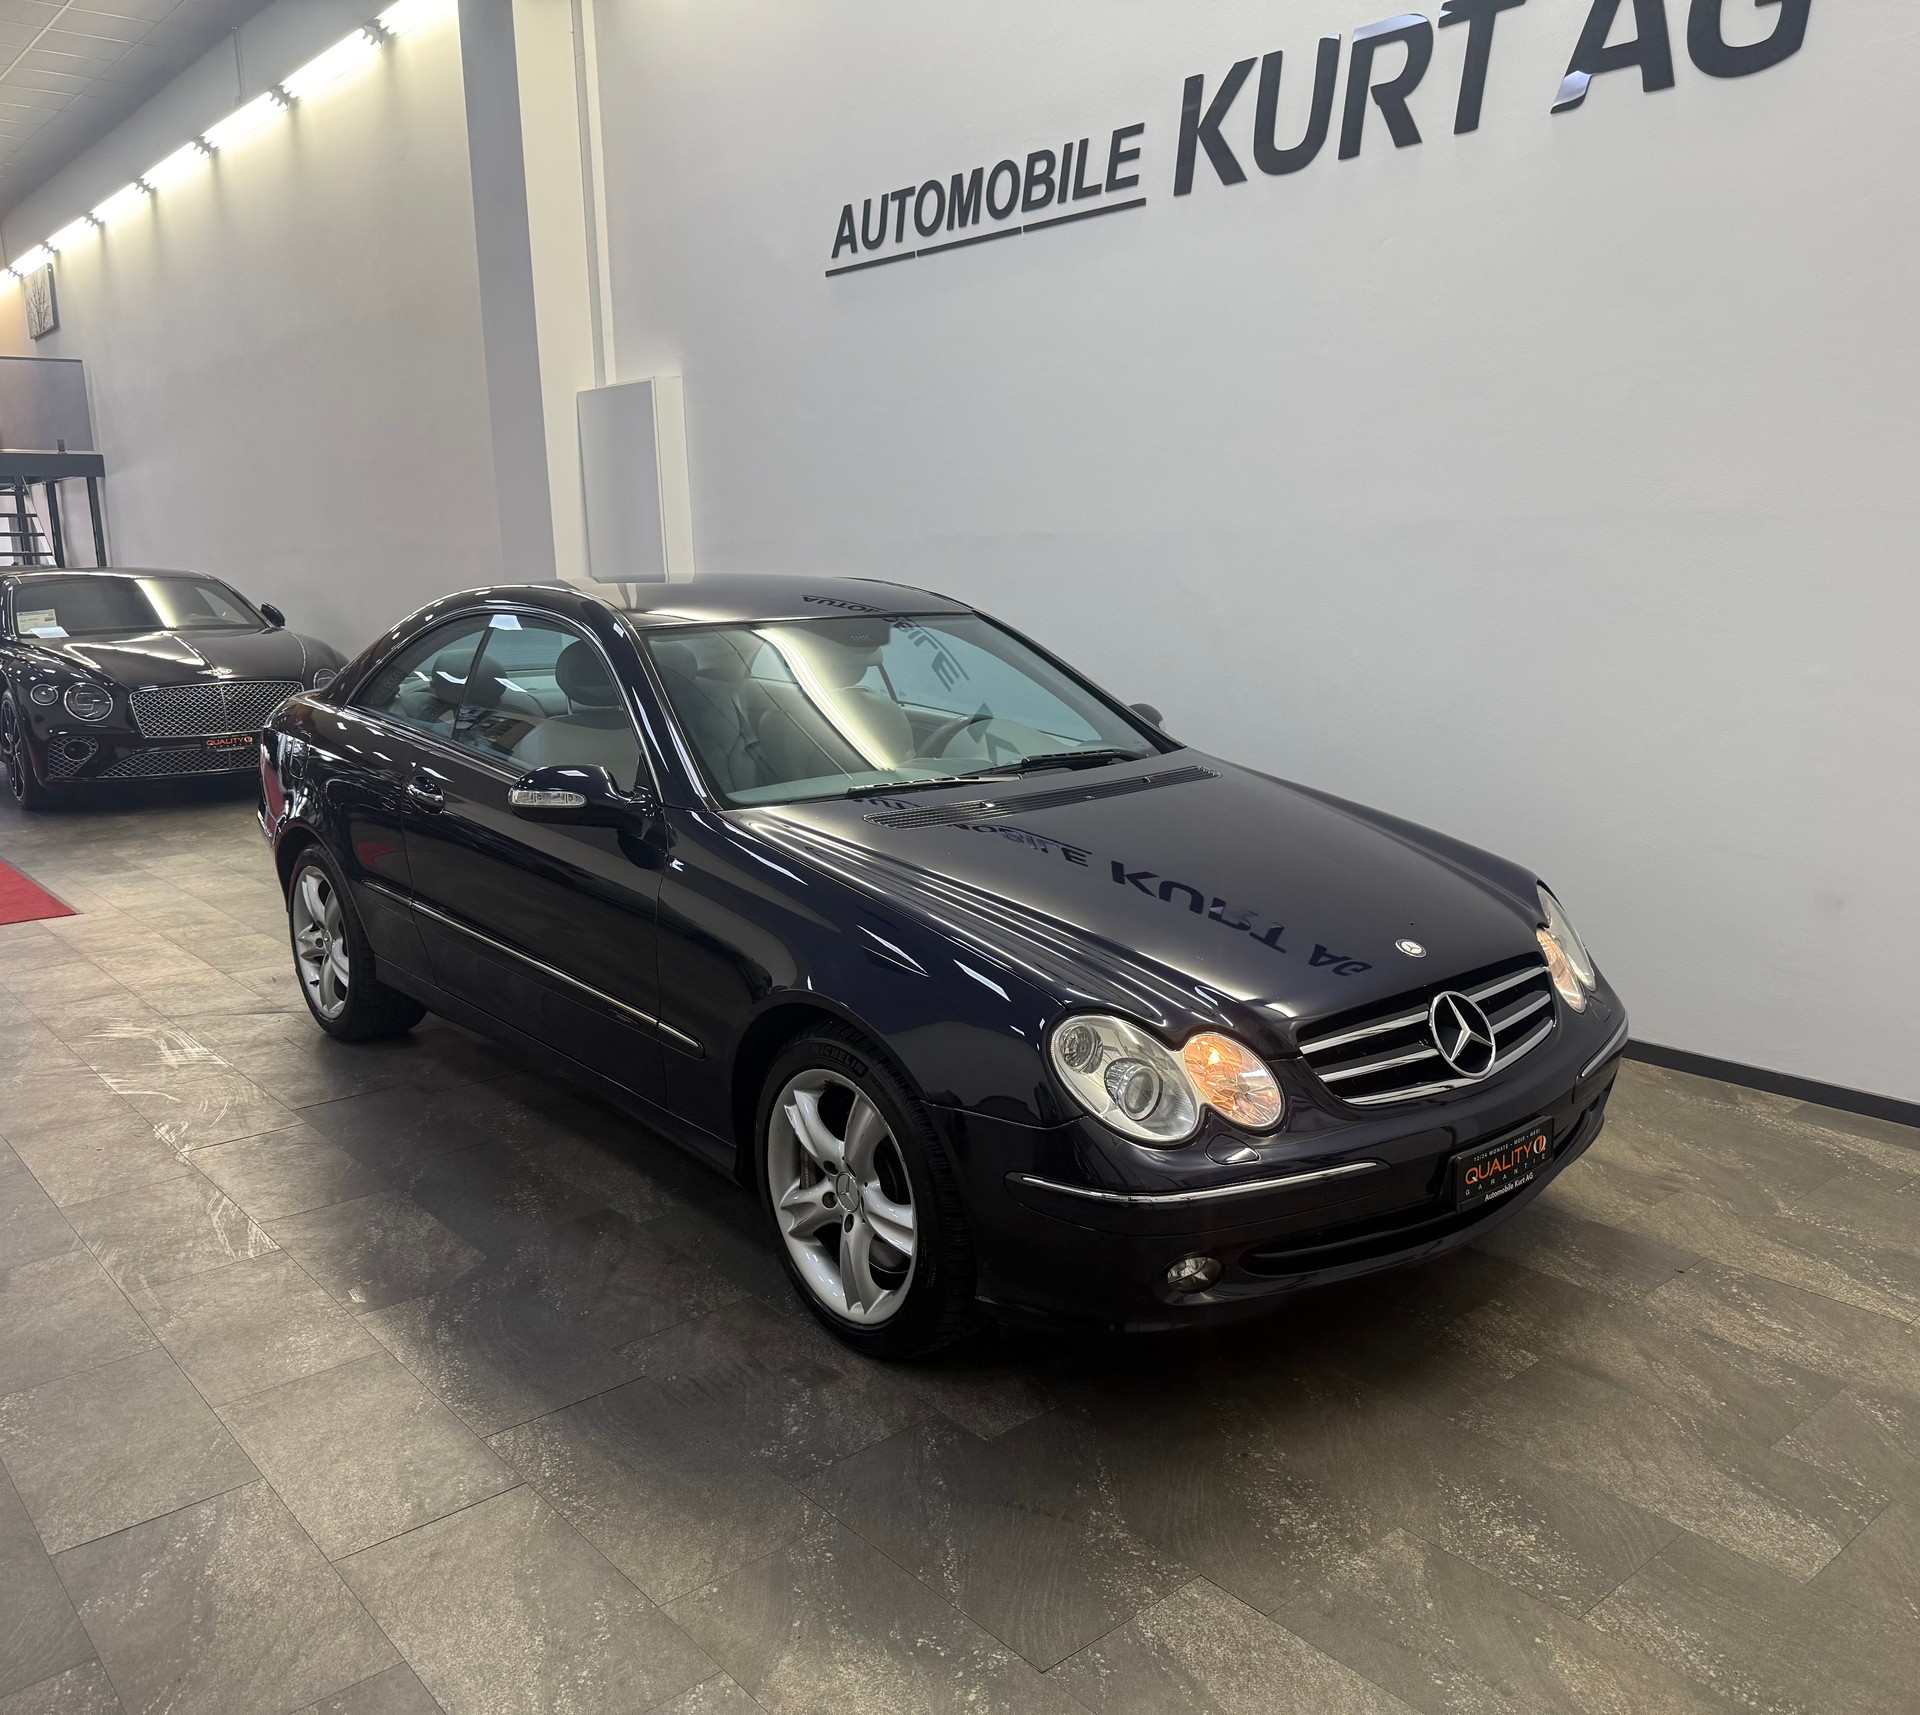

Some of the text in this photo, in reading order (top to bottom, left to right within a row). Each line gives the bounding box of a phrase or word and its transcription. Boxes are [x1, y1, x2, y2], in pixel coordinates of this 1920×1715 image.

[831, 122, 1145, 259] AUTOMOBILE
[1173, 0, 1526, 197] KURT
[206, 737, 244, 746] QUALITY
[1465, 1141, 1533, 1185] QUALITY
[1488, 1143, 1509, 1157] MONATE
[1484, 1171, 1534, 1202] Automobile Kurt AG
